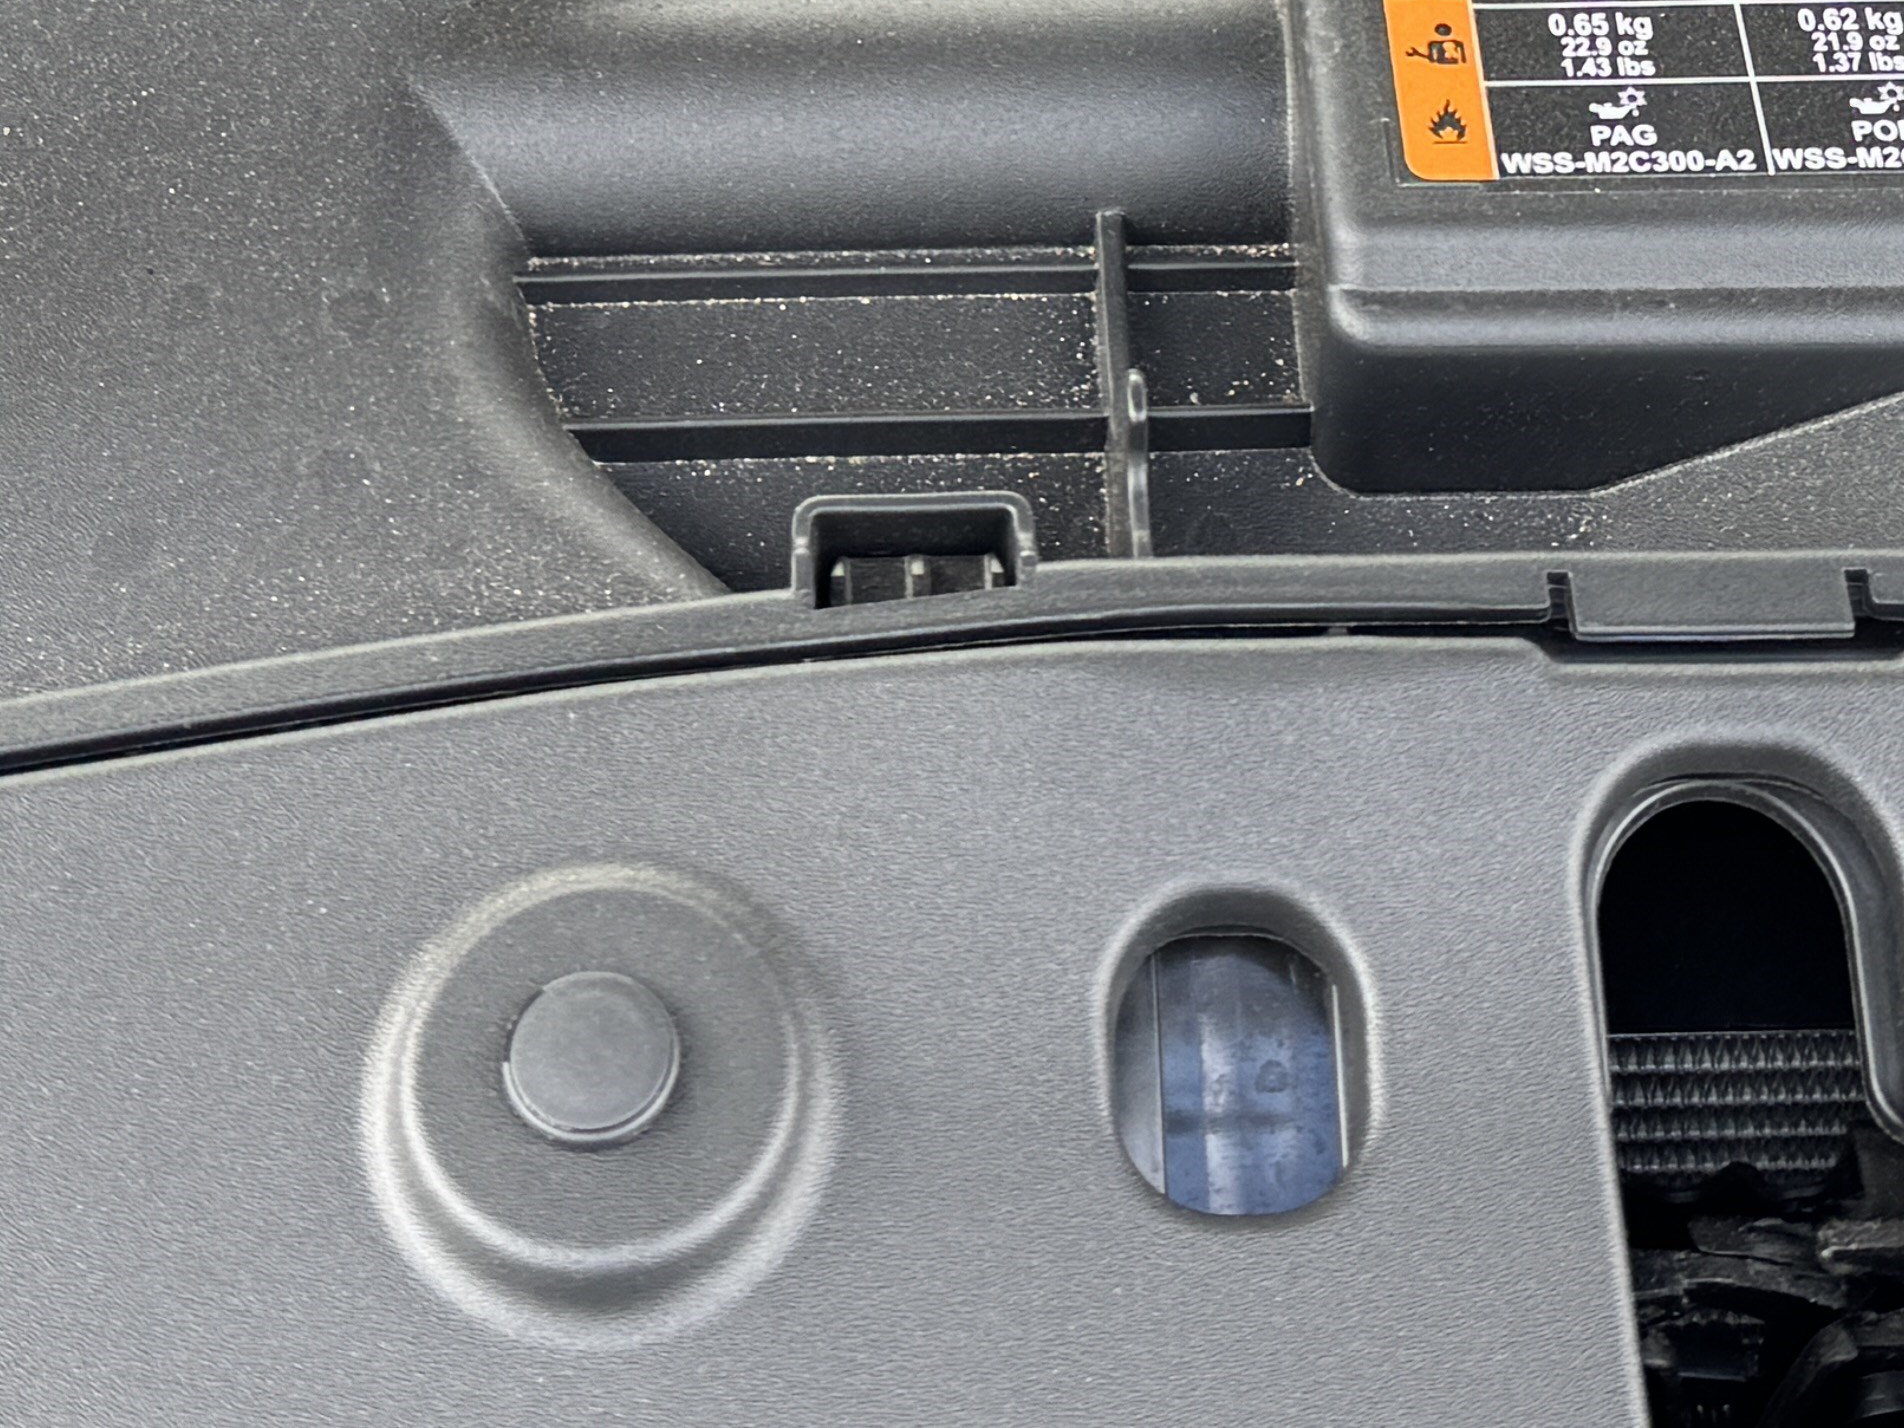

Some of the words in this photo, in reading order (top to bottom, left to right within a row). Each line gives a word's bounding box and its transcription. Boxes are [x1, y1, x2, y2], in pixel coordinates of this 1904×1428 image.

[1547, 13, 1610, 37] 0.65
[1615, 12, 1654, 41] kg
[1797, 7, 1860, 32] 0.62
[1864, 7, 1904, 36] kg
[1560, 37, 1612, 58] 22.9
[1618, 39, 1649, 56] oz
[1810, 31, 1864, 52] 21.9
[1869, 34, 1900, 51] oz
[1560, 57, 1612, 78] 1.43
[1617, 56, 1656, 76] lbs
[1812, 52, 1862, 73] 1.37
[1590, 124, 1658, 147] PAG
[1500, 148, 1757, 174] WSS-M2C300-A2
